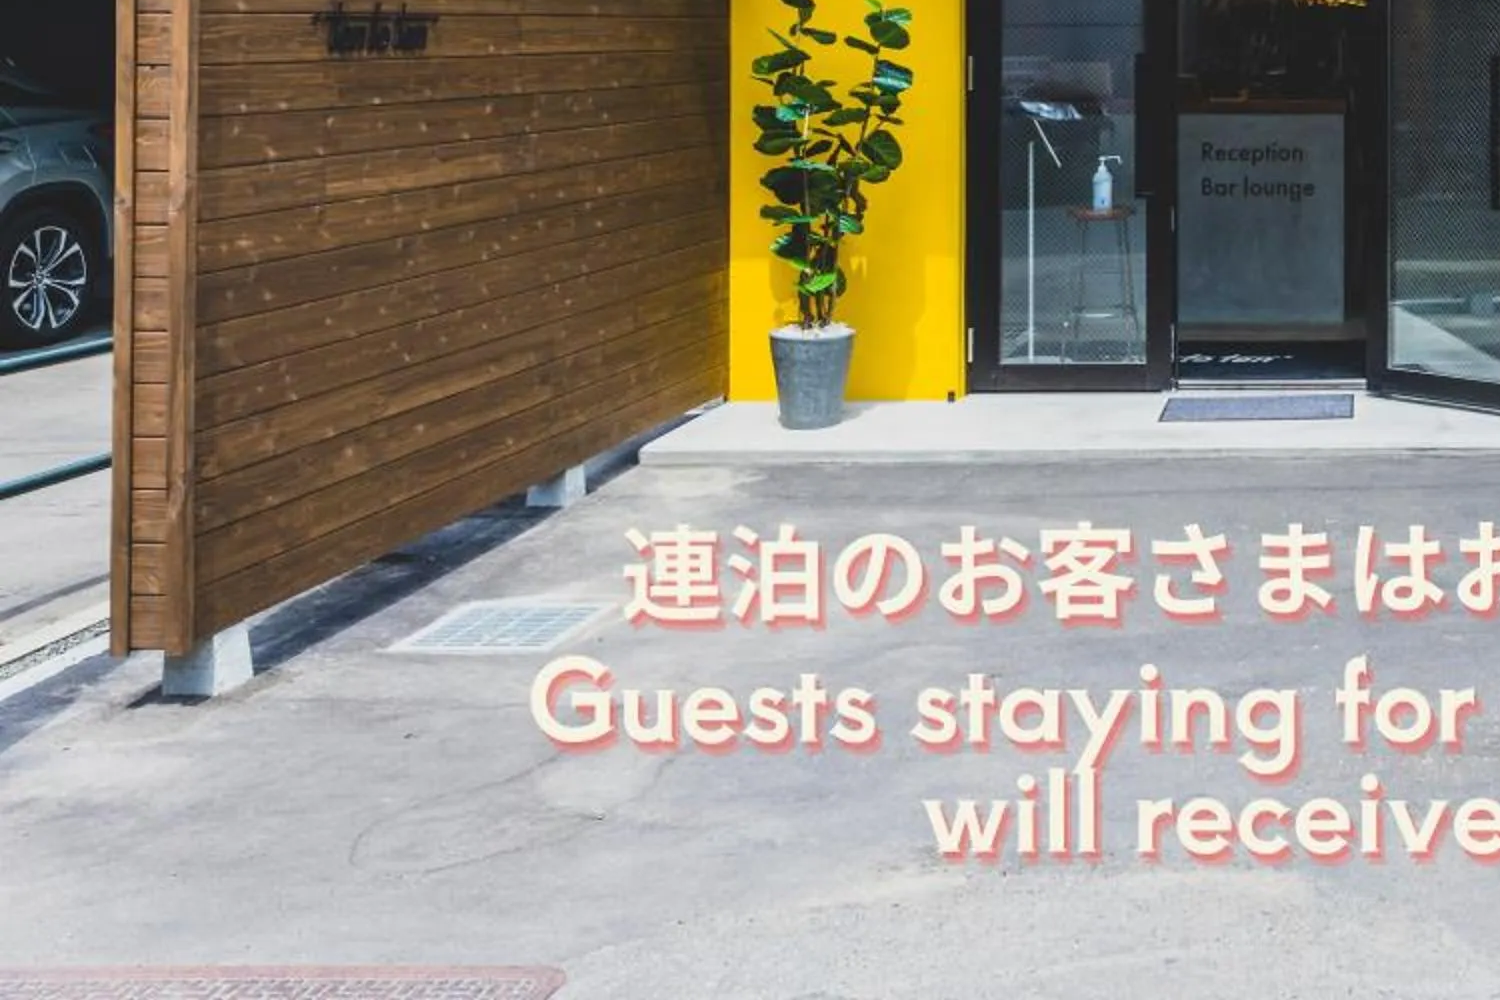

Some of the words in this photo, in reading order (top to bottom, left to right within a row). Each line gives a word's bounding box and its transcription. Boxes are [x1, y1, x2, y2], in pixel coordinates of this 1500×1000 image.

[1201, 141, 1304, 165] Reception
[1201, 177, 1236, 197] Bar
[1244, 176, 1315, 201] lounge
